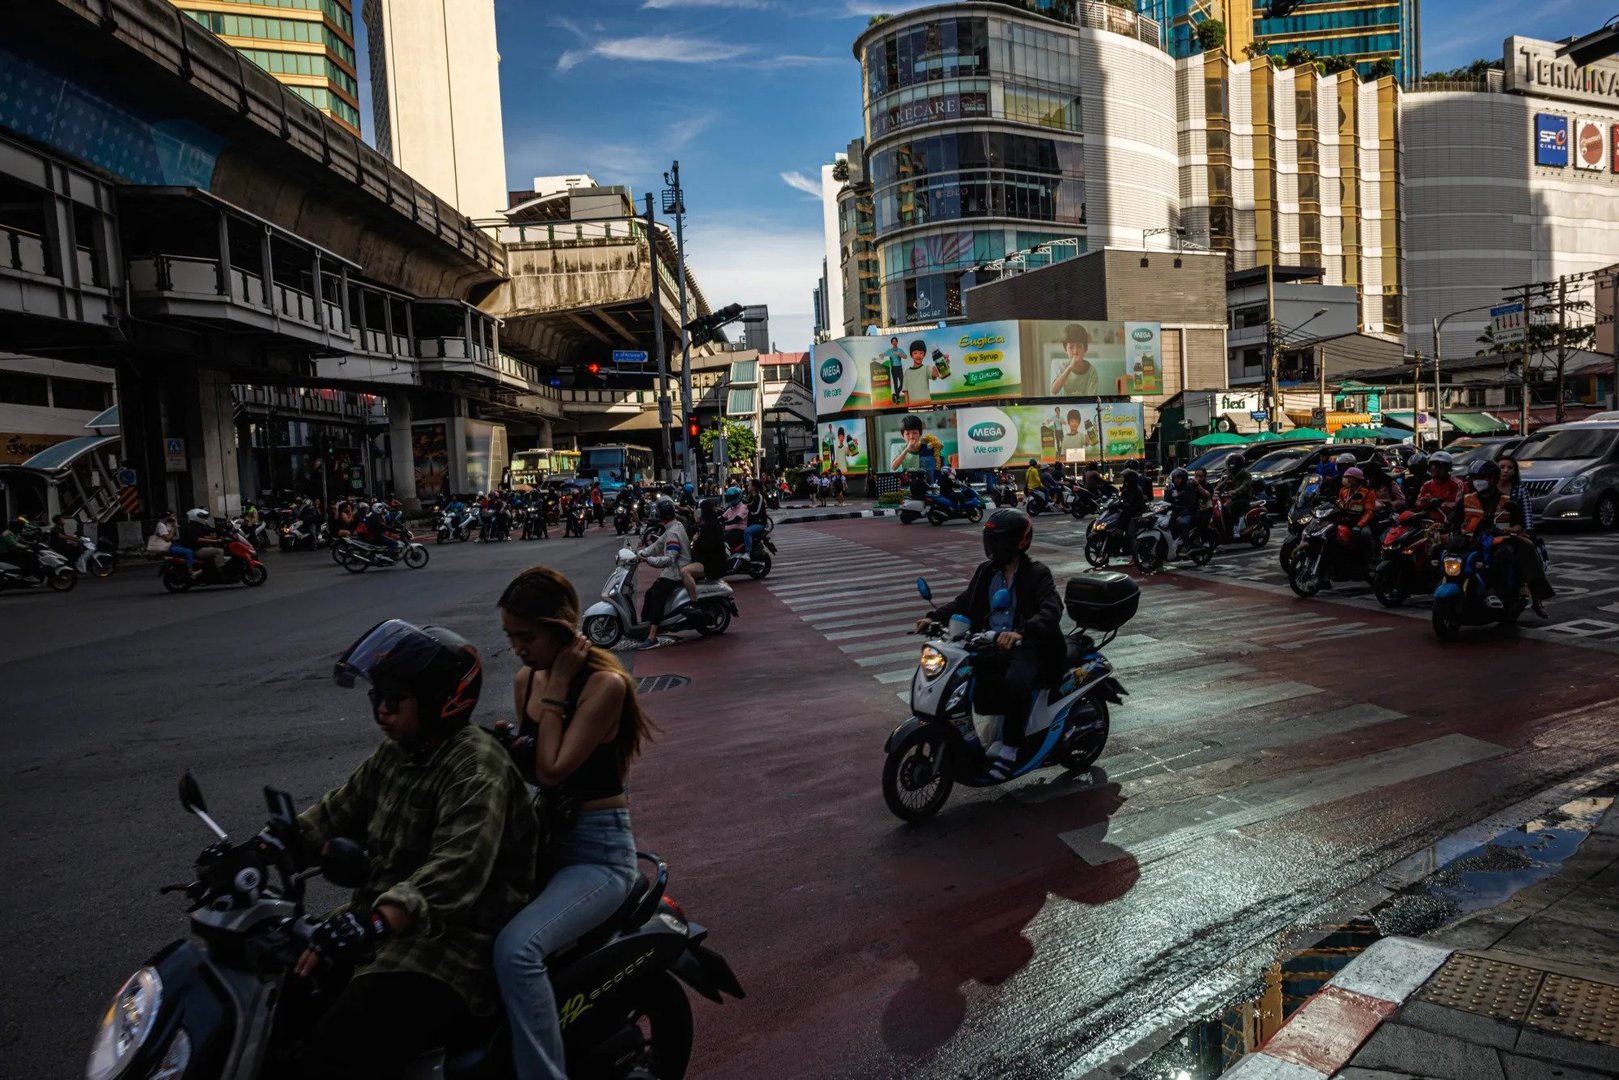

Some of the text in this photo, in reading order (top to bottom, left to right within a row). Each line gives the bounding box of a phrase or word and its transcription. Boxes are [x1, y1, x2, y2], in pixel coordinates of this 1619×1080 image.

[959, 335, 1005, 349] Eugica
[979, 353, 999, 361] Syrup
[822, 364, 840, 378] MEGA
[823, 388, 842, 399] We care
[972, 428, 1003, 437] MEGA
